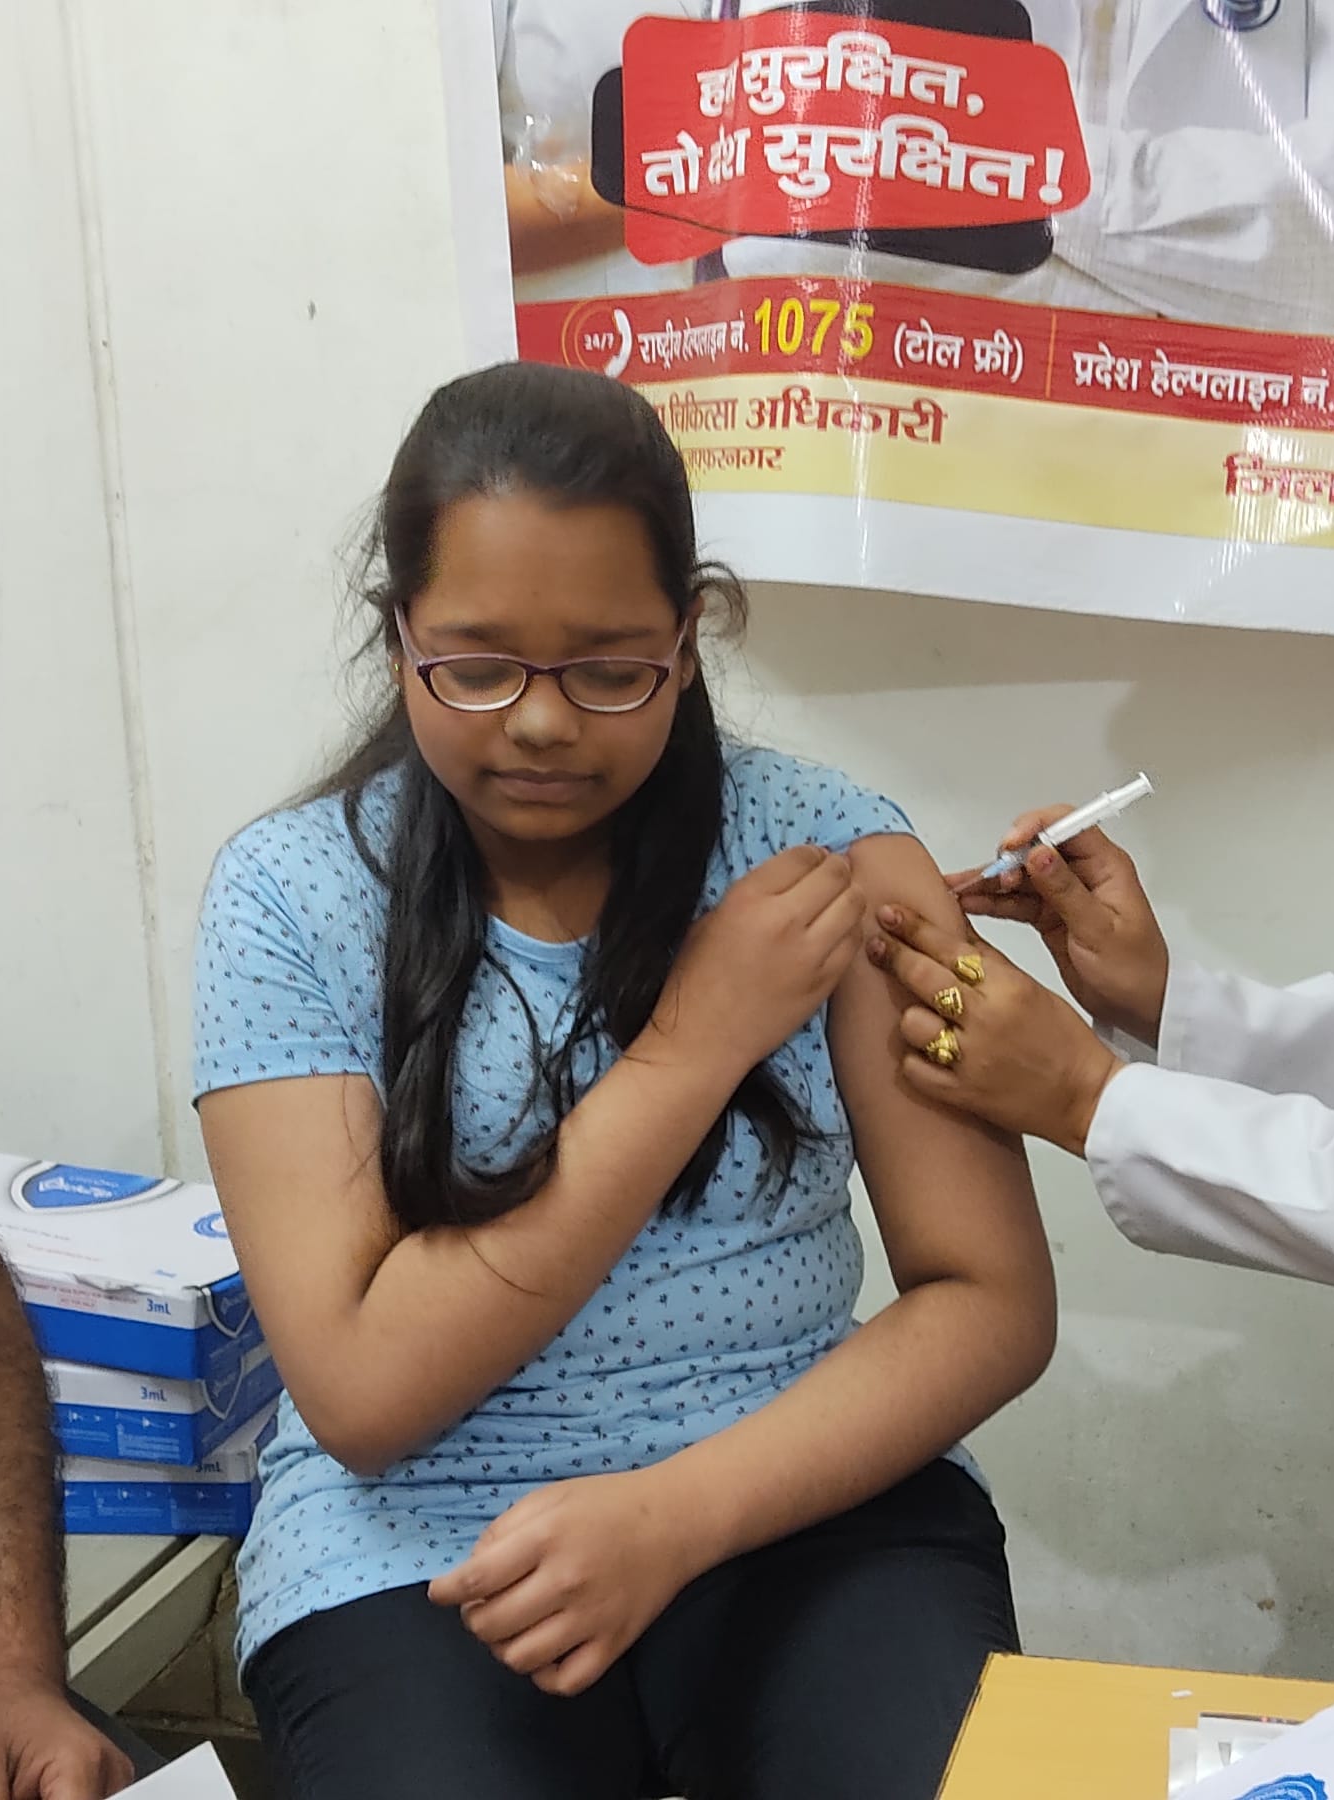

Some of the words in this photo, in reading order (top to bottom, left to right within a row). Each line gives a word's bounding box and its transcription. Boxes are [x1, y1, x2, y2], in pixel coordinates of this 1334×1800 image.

[742, 30, 985, 117] सुरक्षित,
[642, 129, 704, 196] तो
[754, 296, 875, 359] 1075
[893, 320, 964, 371] (टोल
[972, 328, 1025, 384] फ्री)
[1073, 341, 1140, 392] प्रदेश
[1151, 348, 1292, 412] हेल्पलाइन
[745, 383, 949, 445] अधिकारी
